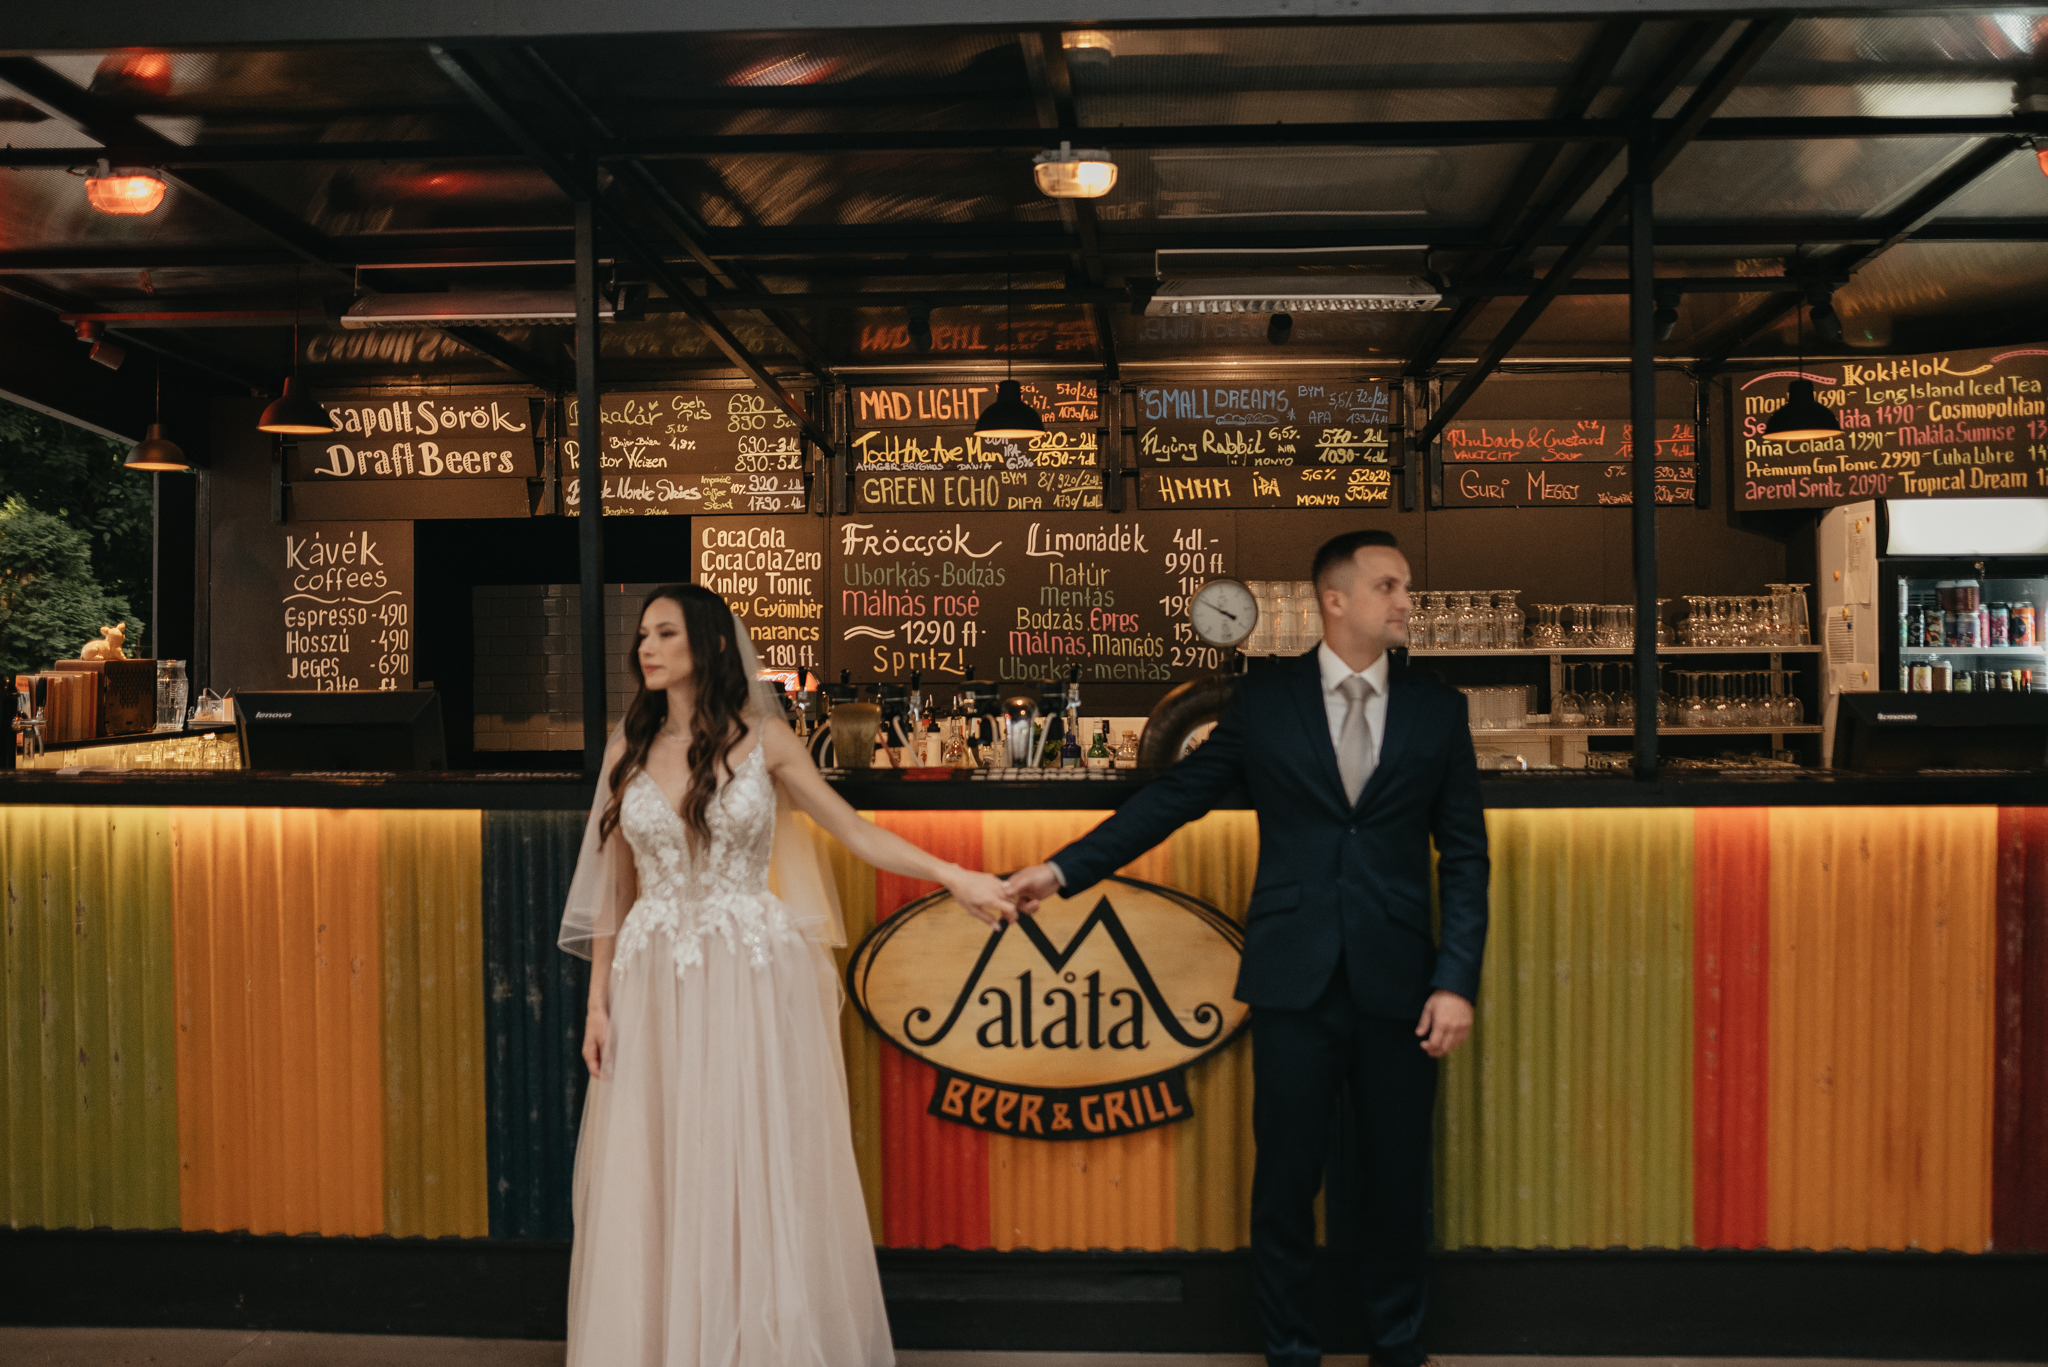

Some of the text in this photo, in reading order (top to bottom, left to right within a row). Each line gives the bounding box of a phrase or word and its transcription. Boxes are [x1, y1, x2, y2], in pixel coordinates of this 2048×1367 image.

[1298, 385, 1324, 397] BYM
[1865, 375, 2042, 405] Long Island Iced Tea
[860, 390, 912, 420] MAD
[919, 388, 988, 420] LIGHT
[1145, 389, 1289, 420] SMALL DREAMS
[1929, 395, 2045, 421] Cosmopolitan
[322, 401, 526, 437] sapolt Sörök
[1042, 412, 1055, 422] IPA
[1308, 410, 1331, 424] APA
[851, 431, 899, 464] Todd
[898, 437, 931, 463] the
[965, 436, 1004, 463] Man
[1447, 428, 1524, 449] Rhubarb
[1526, 427, 1542, 448] &
[1543, 425, 1605, 447] Custard
[1745, 439, 1783, 459] Piña
[1785, 437, 1845, 454] Colada
[314, 441, 514, 477] Draft Beers
[623, 447, 667, 469] Weizen
[1004, 443, 1021, 457] IPA
[1541, 448, 1583, 462] Sour
[1813, 457, 1837, 474] Gin
[1836, 455, 1878, 472] Tonic
[1933, 448, 1971, 465] Cuba
[1974, 445, 2015, 464] Libre
[862, 475, 999, 506] GREEN ECHO
[1001, 471, 1027, 486] BYM
[1158, 476, 1231, 503] HMMM
[1798, 476, 1845, 498] Spritz
[1898, 468, 1965, 497] Tropical
[1969, 467, 2028, 489] Dream
[1008, 496, 1042, 510] DIPA
[286, 530, 383, 571] Kávék
[841, 522, 1002, 558] Fröccsök
[1026, 522, 1149, 557] Limonádék
[1050, 562, 1111, 586] Natúr
[1165, 553, 1205, 575] 990
[294, 567, 387, 591] coffees
[700, 572, 812, 596] Kinley Tonic
[842, 589, 980, 617] Málnás rosé
[1040, 586, 1115, 607] Mentás
[284, 607, 367, 632] Espresso
[286, 628, 350, 654] Hosszú
[750, 625, 820, 641] narancs
[900, 620, 955, 645] 1290
[1093, 633, 1164, 658] Mangós
[873, 645, 966, 676] Spritz!
[255, 711, 292, 719] lenovo
[940, 1077, 1184, 1135] BEER & GRILL
